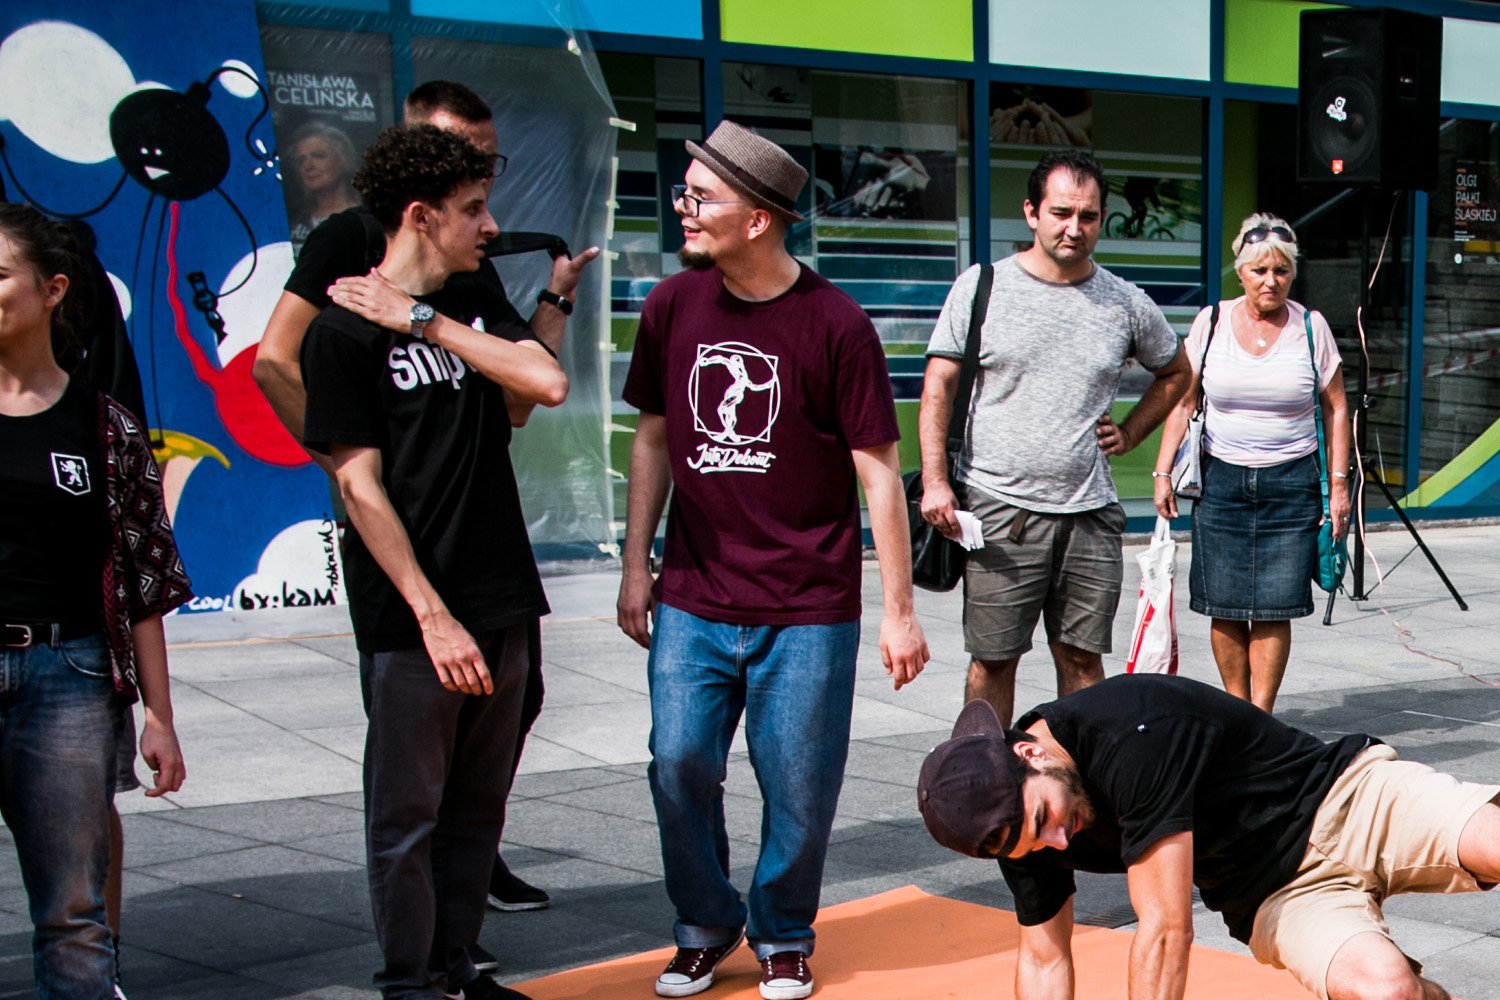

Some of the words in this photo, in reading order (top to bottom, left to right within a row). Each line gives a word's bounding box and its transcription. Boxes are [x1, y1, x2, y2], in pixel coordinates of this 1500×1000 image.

[266, 71, 356, 90] TANISŁAWA
[274, 87, 375, 108] CELIŃSKA
[388, 336, 478, 391] snip
